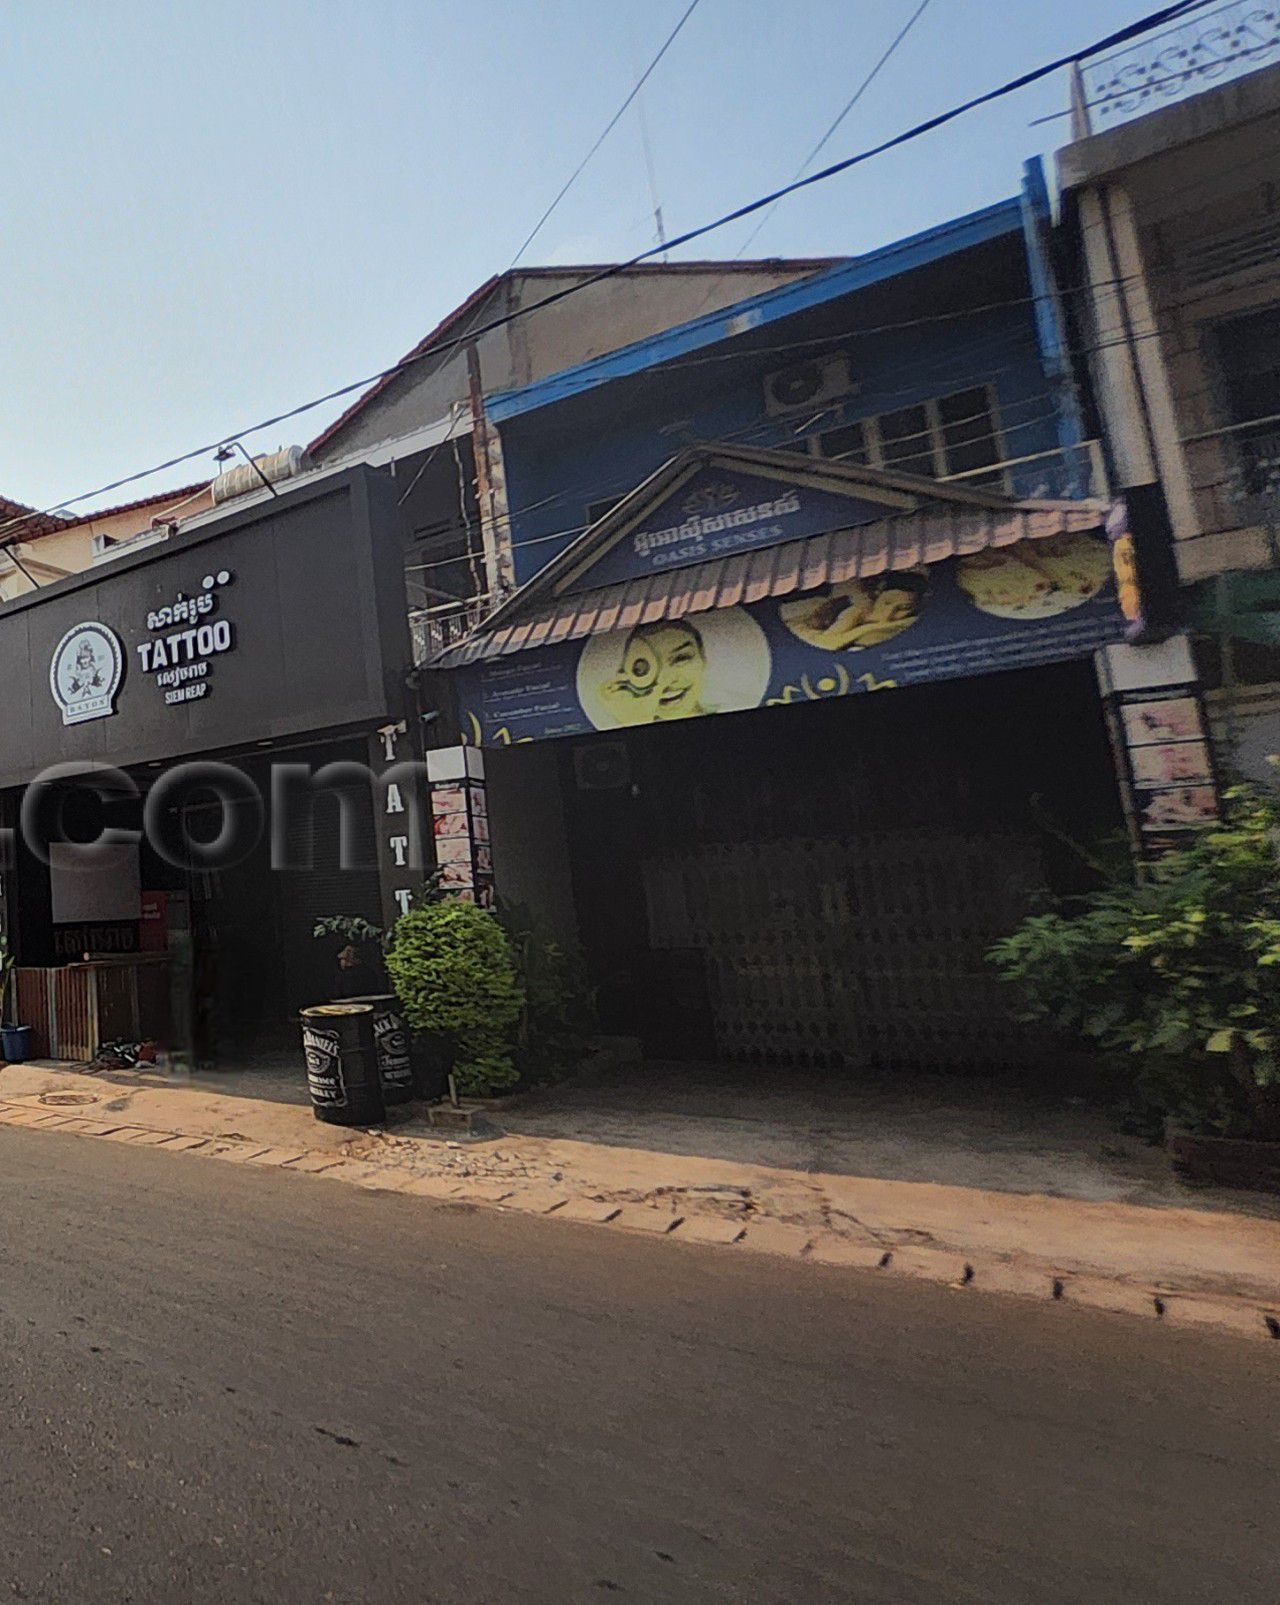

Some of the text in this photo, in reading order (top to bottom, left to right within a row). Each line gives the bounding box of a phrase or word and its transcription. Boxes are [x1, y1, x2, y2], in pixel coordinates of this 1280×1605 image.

[652, 524, 783, 566] OASIS SENSES
[137, 620, 231, 672] TATTOO
[165, 683, 206, 704] SIEM REAP
